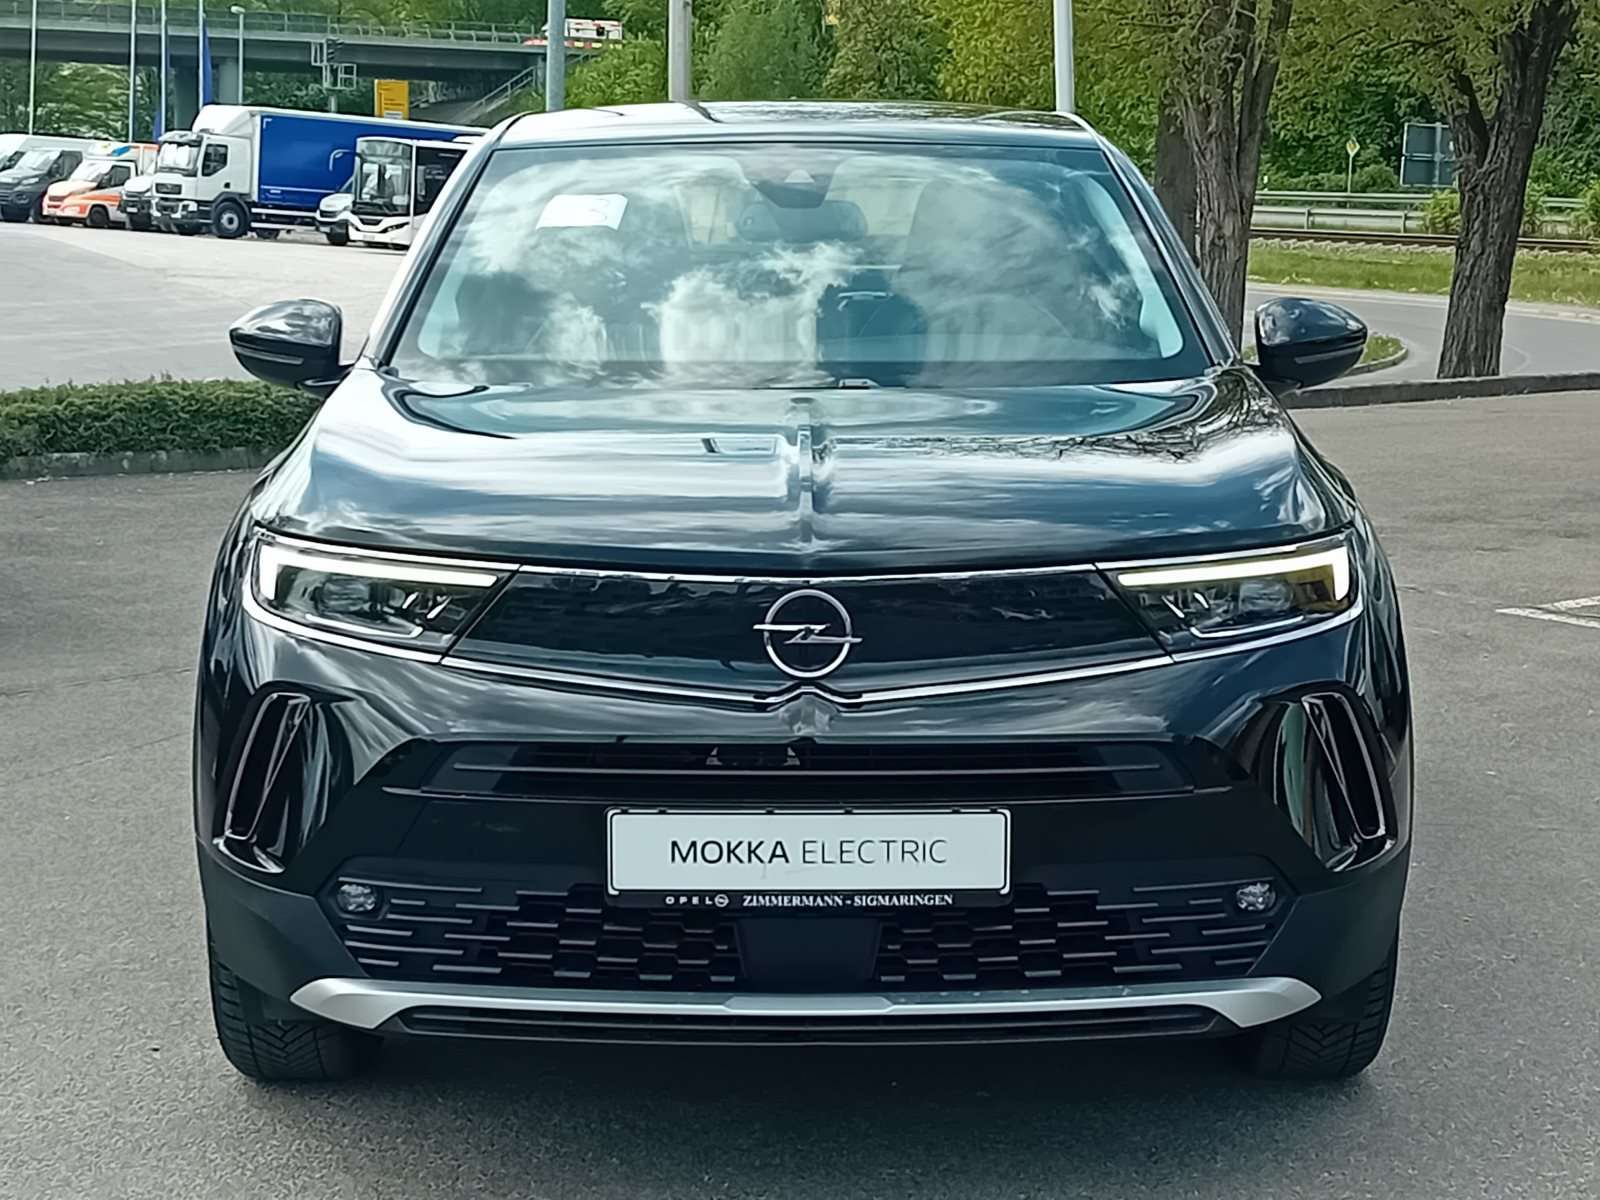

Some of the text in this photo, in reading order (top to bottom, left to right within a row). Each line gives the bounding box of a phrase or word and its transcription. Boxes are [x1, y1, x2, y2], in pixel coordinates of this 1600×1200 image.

[670, 839, 948, 865] MOKKA ELECTRIC
[665, 895, 713, 905] OPEL
[742, 894, 843, 907] ZIMMERMANN
[853, 894, 953, 906] SIGMARINGEN
